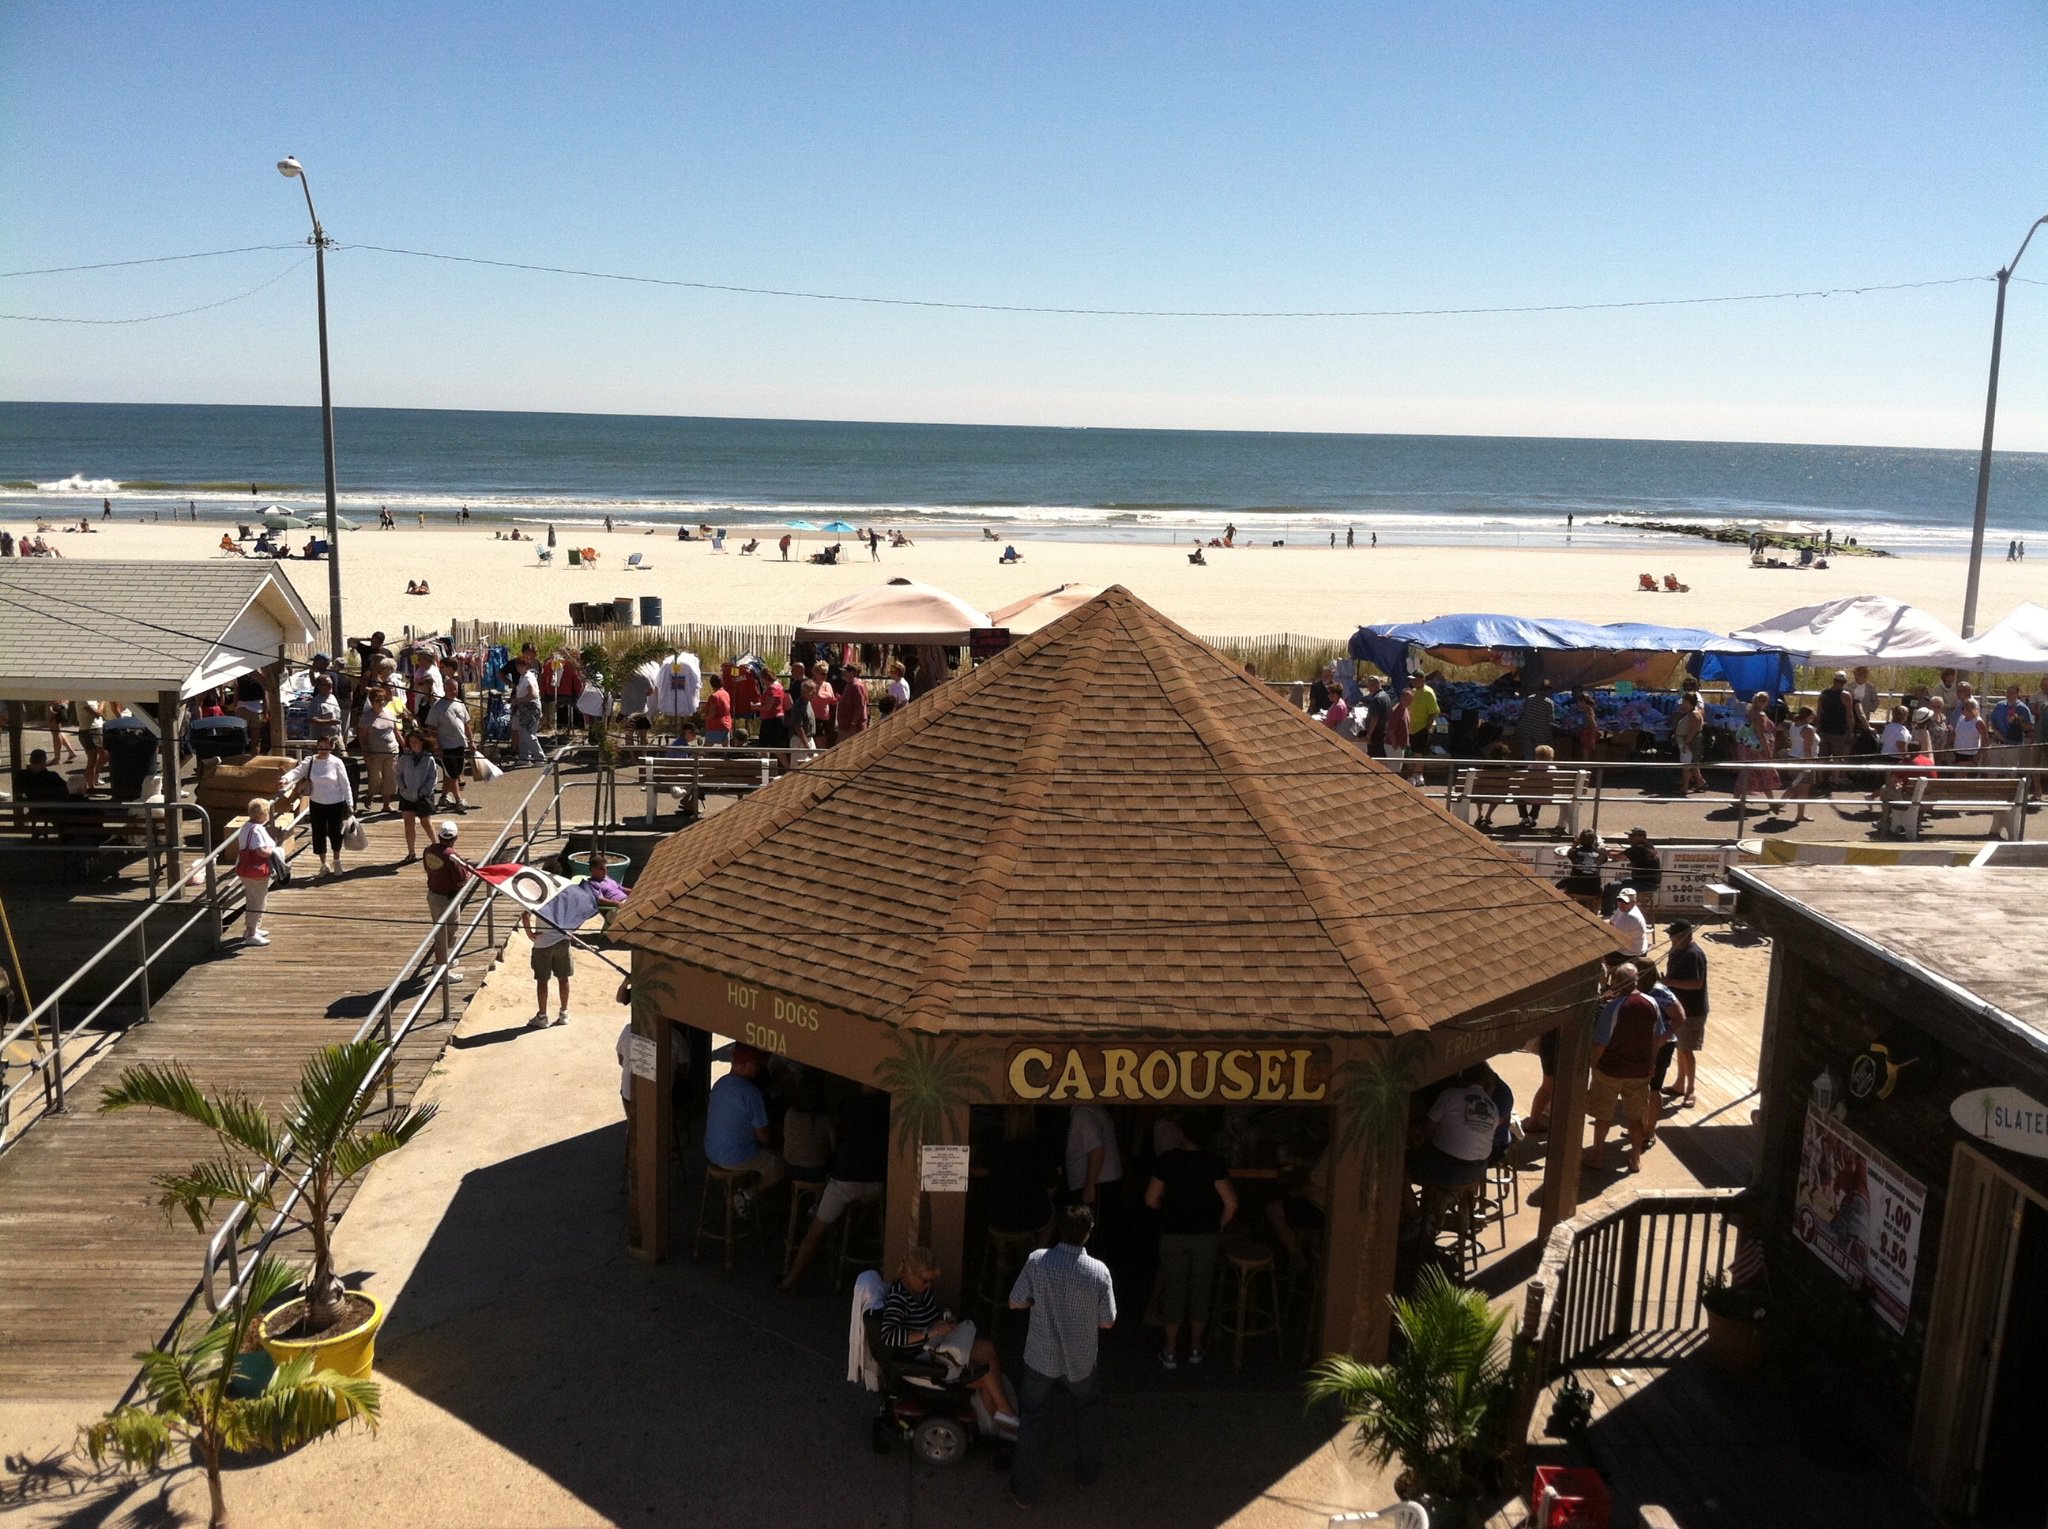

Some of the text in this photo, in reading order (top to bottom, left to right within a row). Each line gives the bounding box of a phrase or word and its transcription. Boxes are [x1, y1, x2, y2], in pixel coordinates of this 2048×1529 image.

[727, 981, 819, 1032] HOT DOGS
[745, 1022, 787, 1056] SODA
[1008, 1048, 1326, 1100] CAROUSEL
[1994, 1105, 2048, 1137] SLATE
